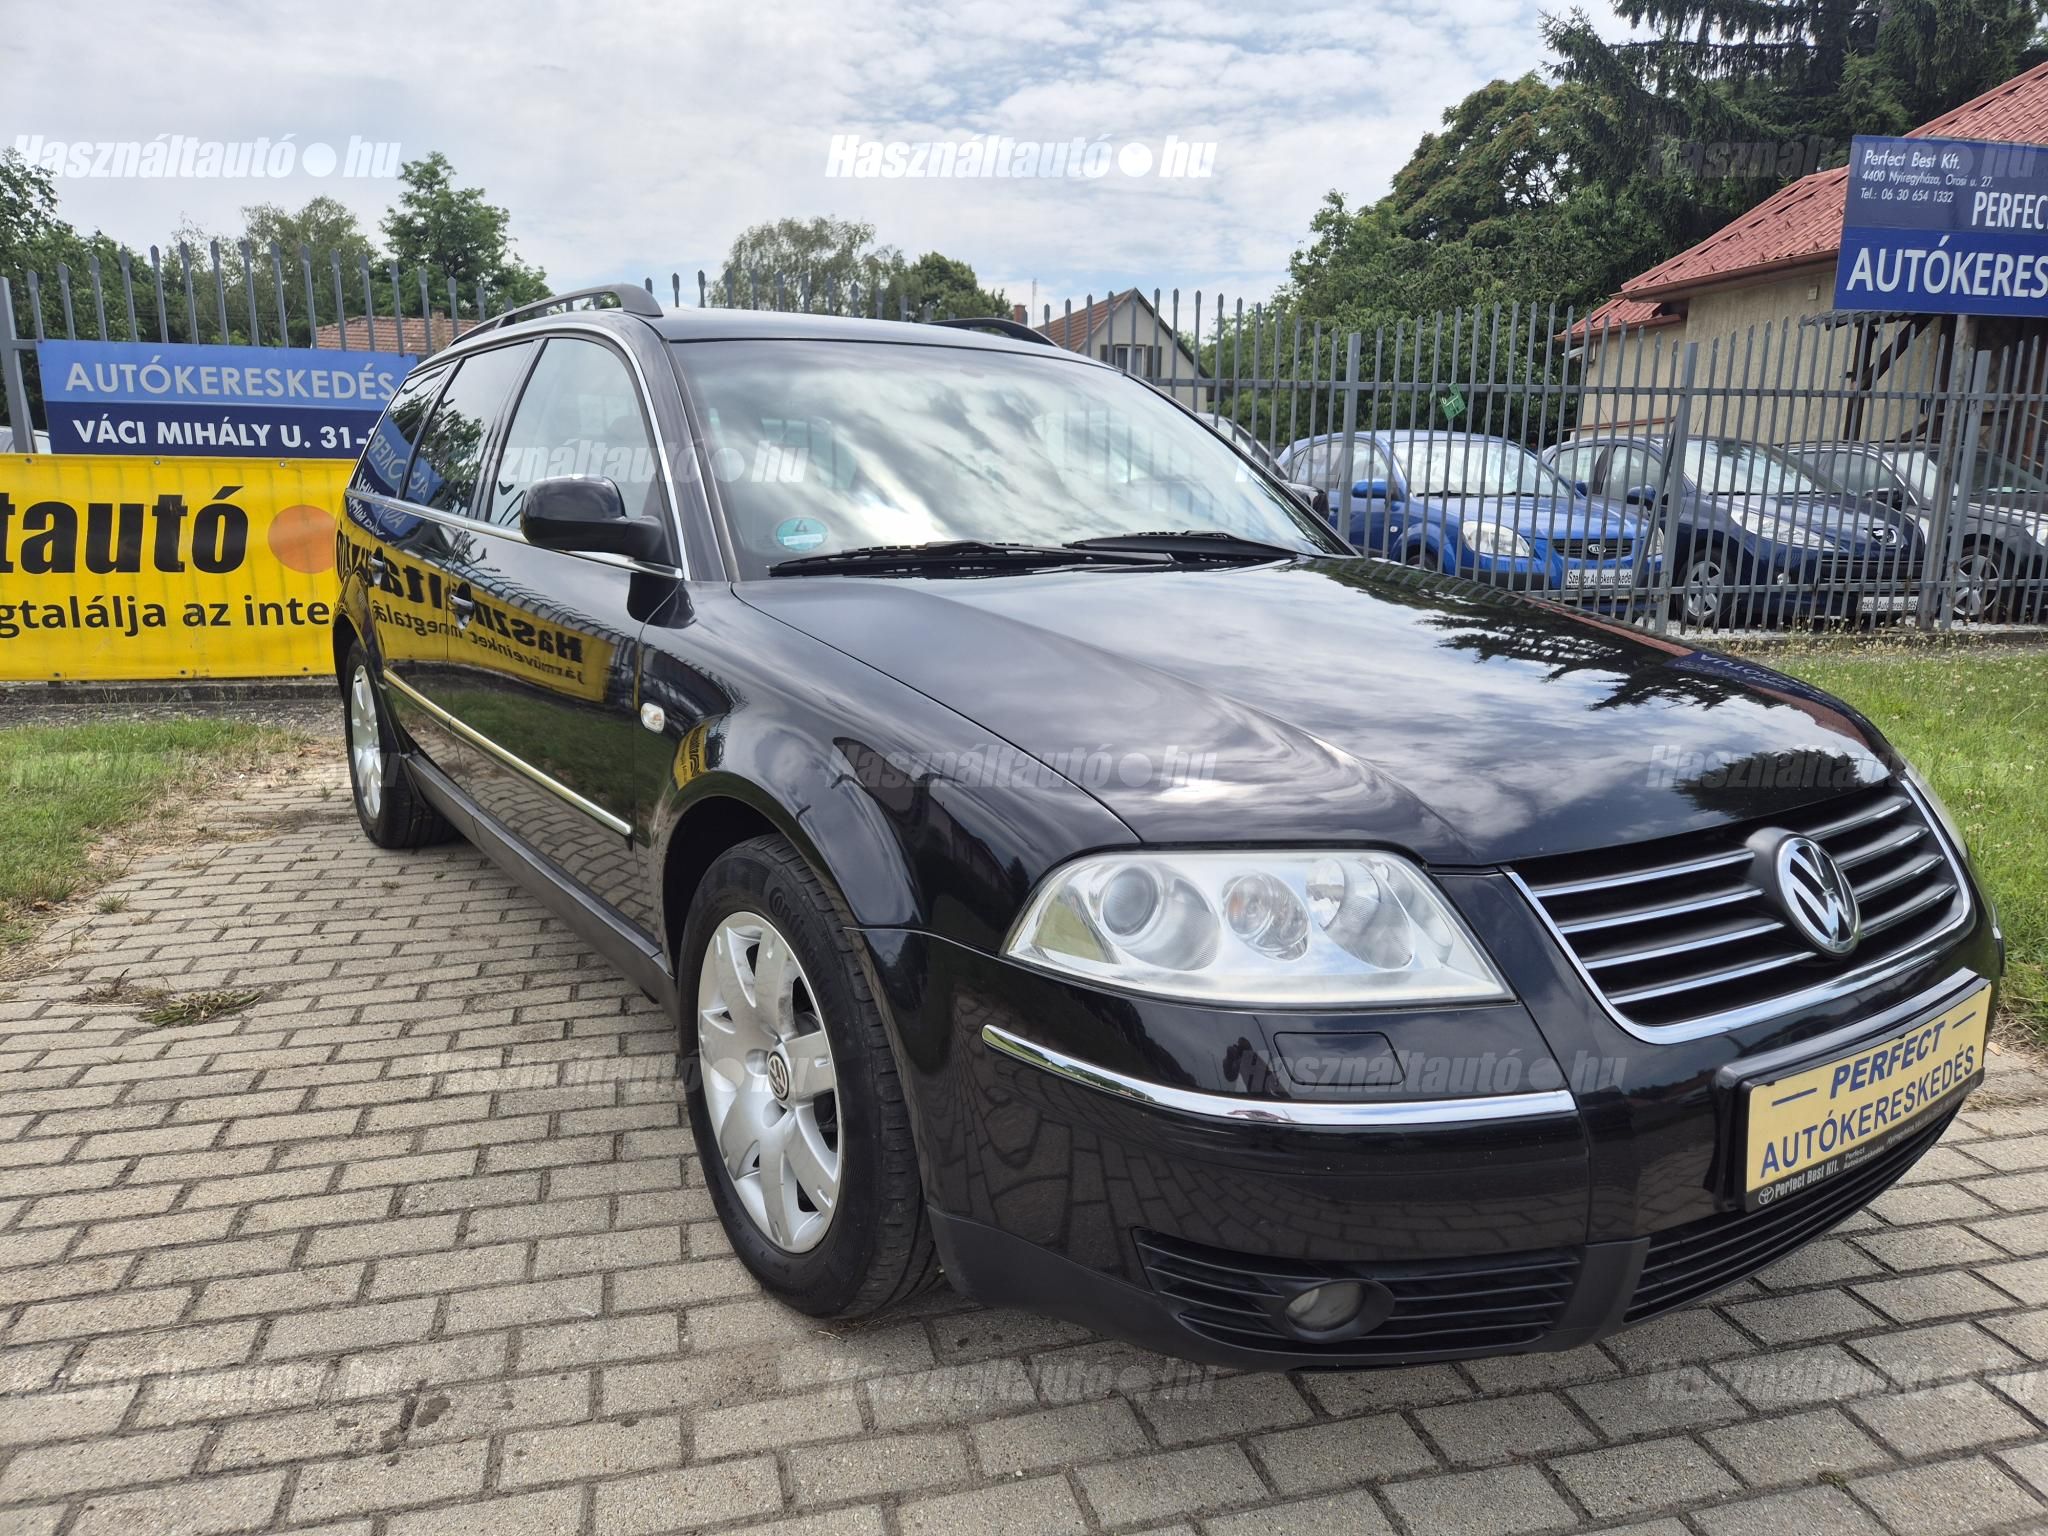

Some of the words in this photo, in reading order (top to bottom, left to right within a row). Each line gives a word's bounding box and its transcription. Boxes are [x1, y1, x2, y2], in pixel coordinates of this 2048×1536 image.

[1864, 150, 1905, 167] Perfect
[1911, 152, 1937, 168] Best
[1941, 152, 1961, 170] Kft.
[1862, 170, 1885, 182] 4400
[1881, 188, 1893, 200] 06
[1896, 189, 1909, 201] 30
[1912, 190, 1929, 201] 654
[1933, 191, 1954, 203] 1332
[65, 354, 398, 402] AUTÓKERESKEDÉS
[72, 414, 146, 445] VÁCI
[157, 416, 272, 447] MIHÁLY
[280, 425, 311, 449] U.
[182, 602, 232, 627] az
[1829, 1020, 1946, 1099] PERFECT
[1760, 1044, 1975, 1178] AUTÓKERESKEDÉS
